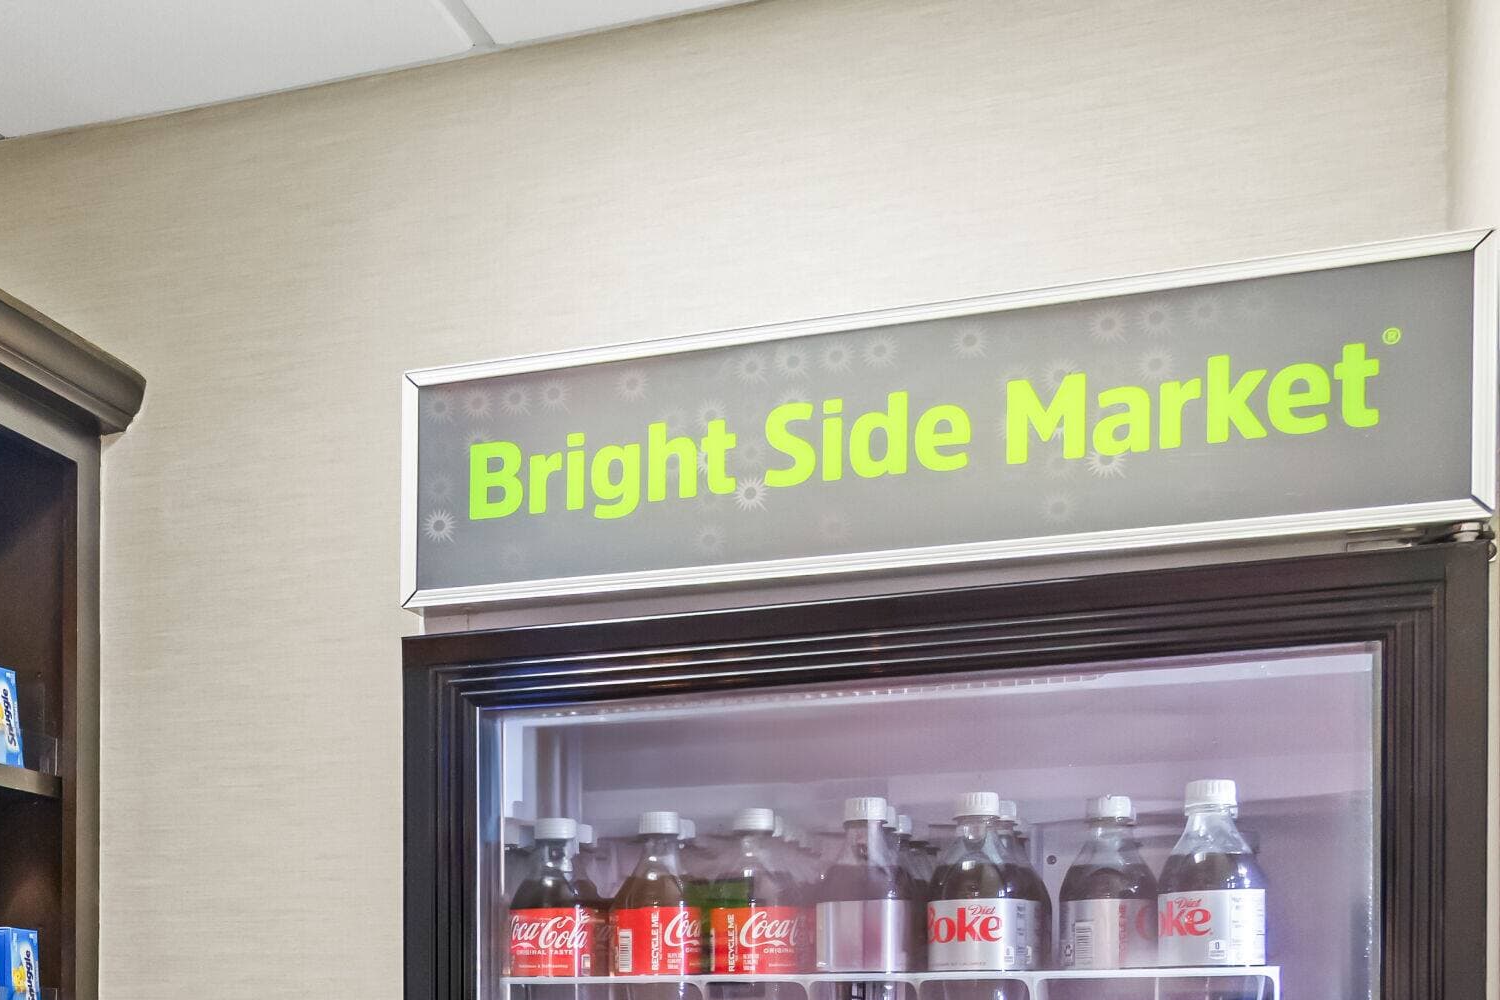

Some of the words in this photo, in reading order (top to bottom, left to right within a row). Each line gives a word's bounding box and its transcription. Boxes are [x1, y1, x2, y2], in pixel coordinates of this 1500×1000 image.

[469, 419, 737, 520] Bright
[764, 391, 971, 488] Side
[968, 904, 996, 915] Diet
[1174, 897, 1203, 909] Diet
[651, 911, 660, 928] ME
[727, 914, 735, 929] ME
[651, 928, 660, 971] RECYCLE
[727, 929, 735, 972] RECYCLE
